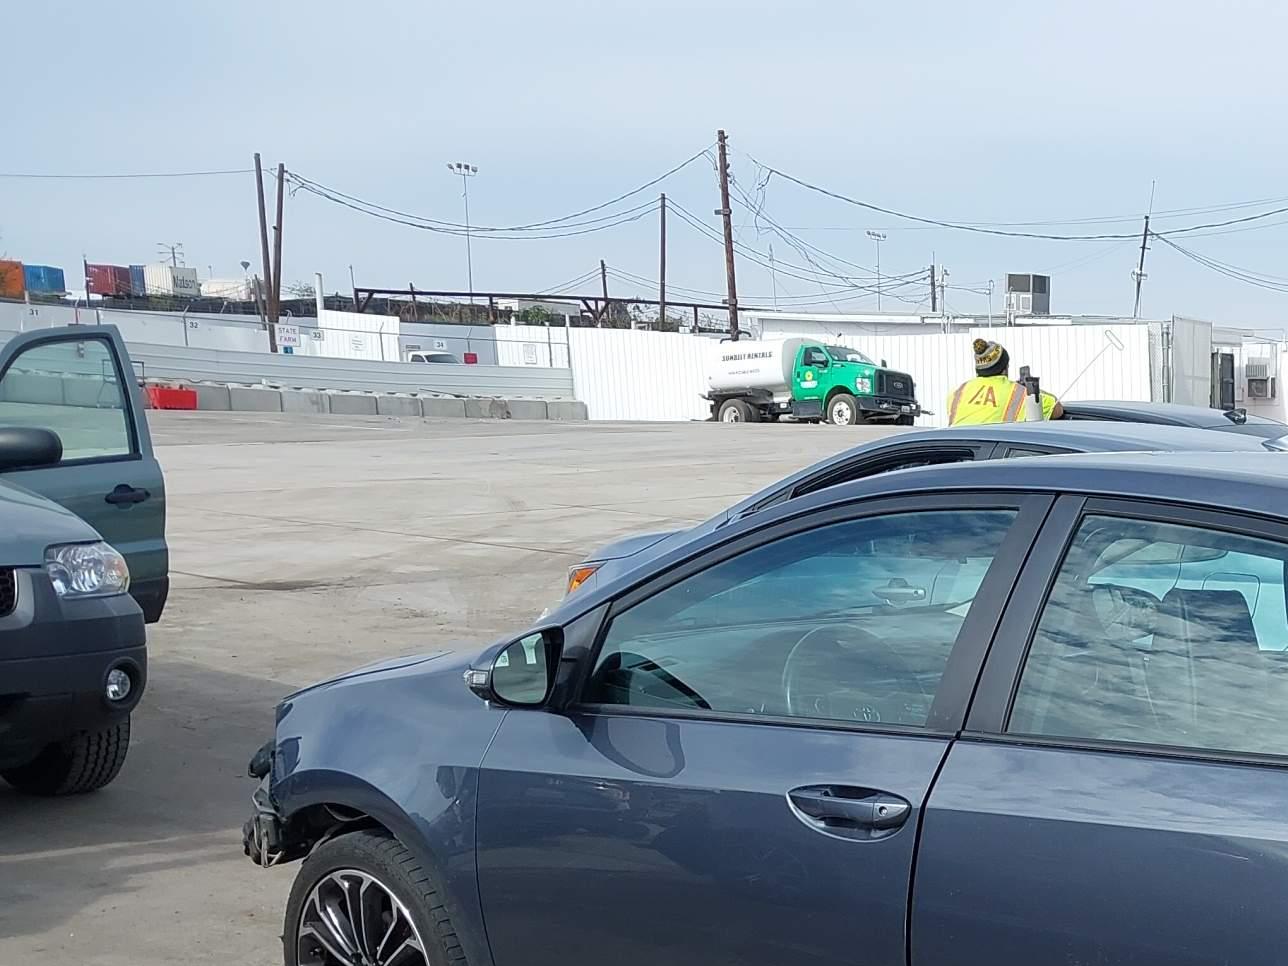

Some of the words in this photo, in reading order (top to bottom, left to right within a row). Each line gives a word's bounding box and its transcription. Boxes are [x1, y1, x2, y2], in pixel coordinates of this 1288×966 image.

[173, 275, 195, 289] Matson
[189, 321, 198, 329] 32
[312, 331, 321, 339] 33
[721, 353, 746, 362] SUNBELT
[747, 351, 773, 360] RENTALS
